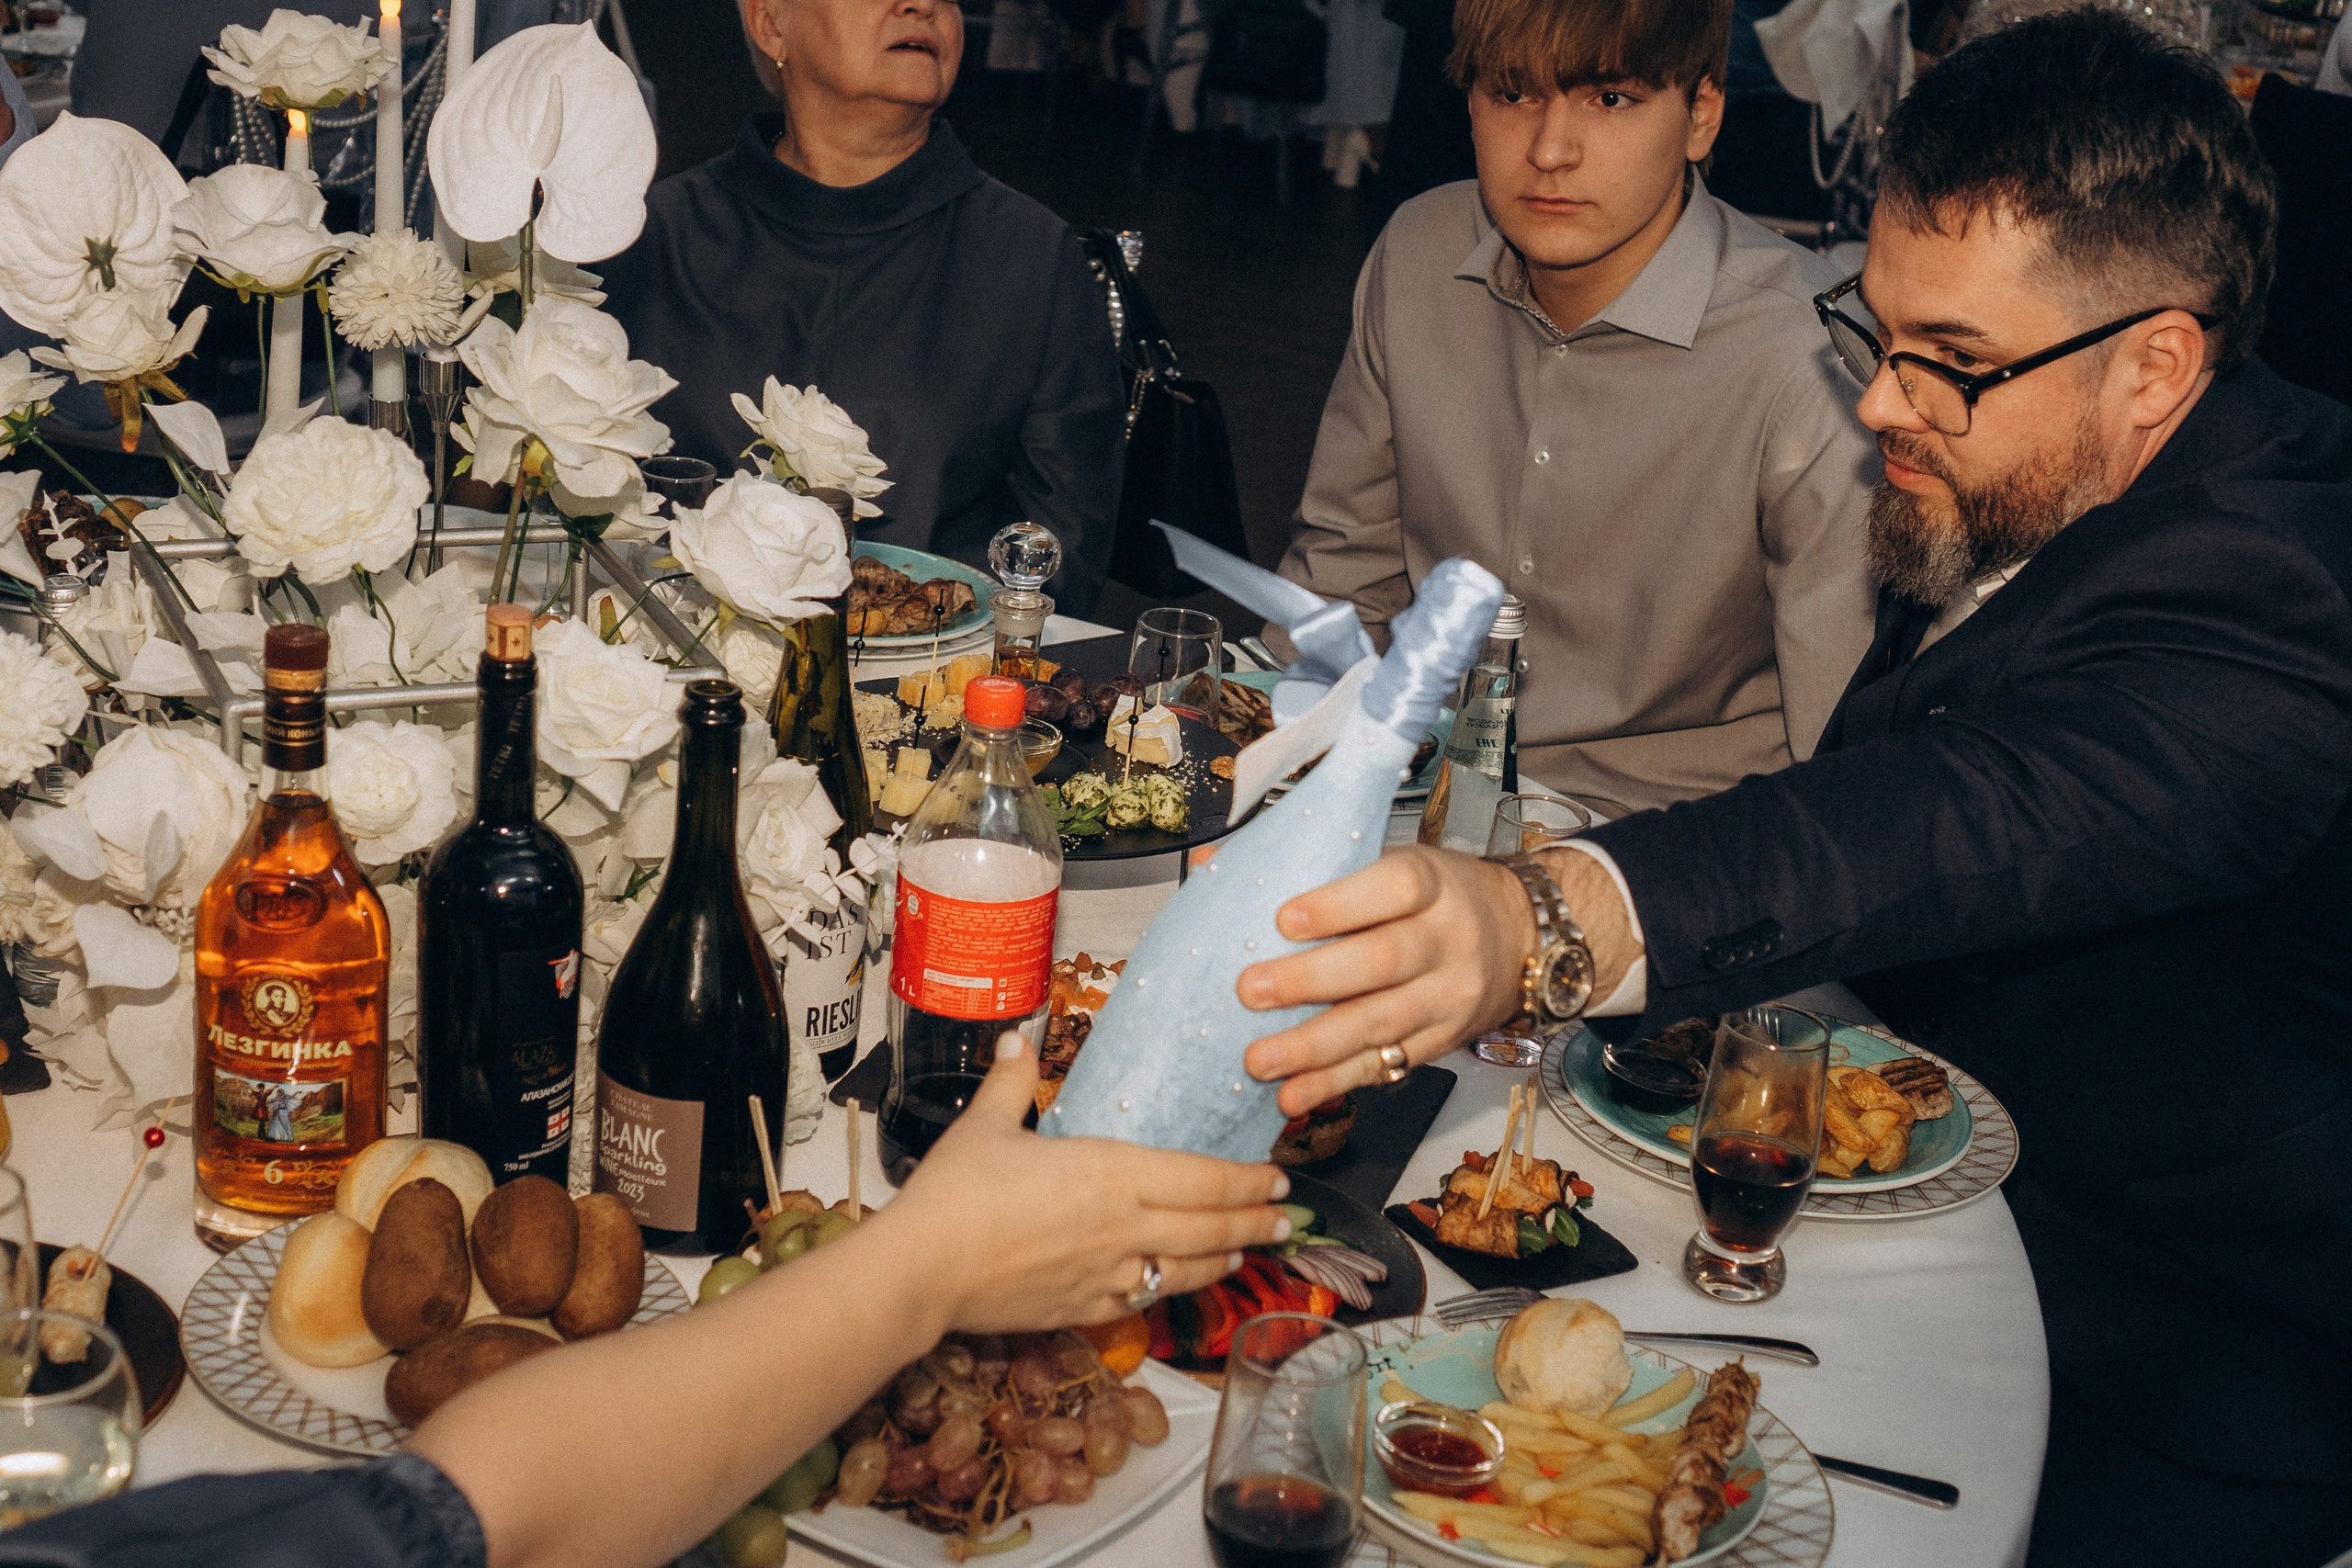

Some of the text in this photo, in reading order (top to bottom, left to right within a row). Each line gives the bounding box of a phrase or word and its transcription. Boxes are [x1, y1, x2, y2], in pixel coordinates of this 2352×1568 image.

[809, 903, 859, 932] DAS
[806, 930, 852, 961] IST
[899, 976, 916, 998] 1 L
[806, 987, 862, 1038] RIESLI
[208, 1024, 353, 1060] ЛЕЗГИНКА
[601, 1107, 666, 1163] BLANC
[264, 1158, 284, 1185] 6
[503, 1159, 529, 1172] 750 ml
[617, 1178, 644, 1203] 2023
